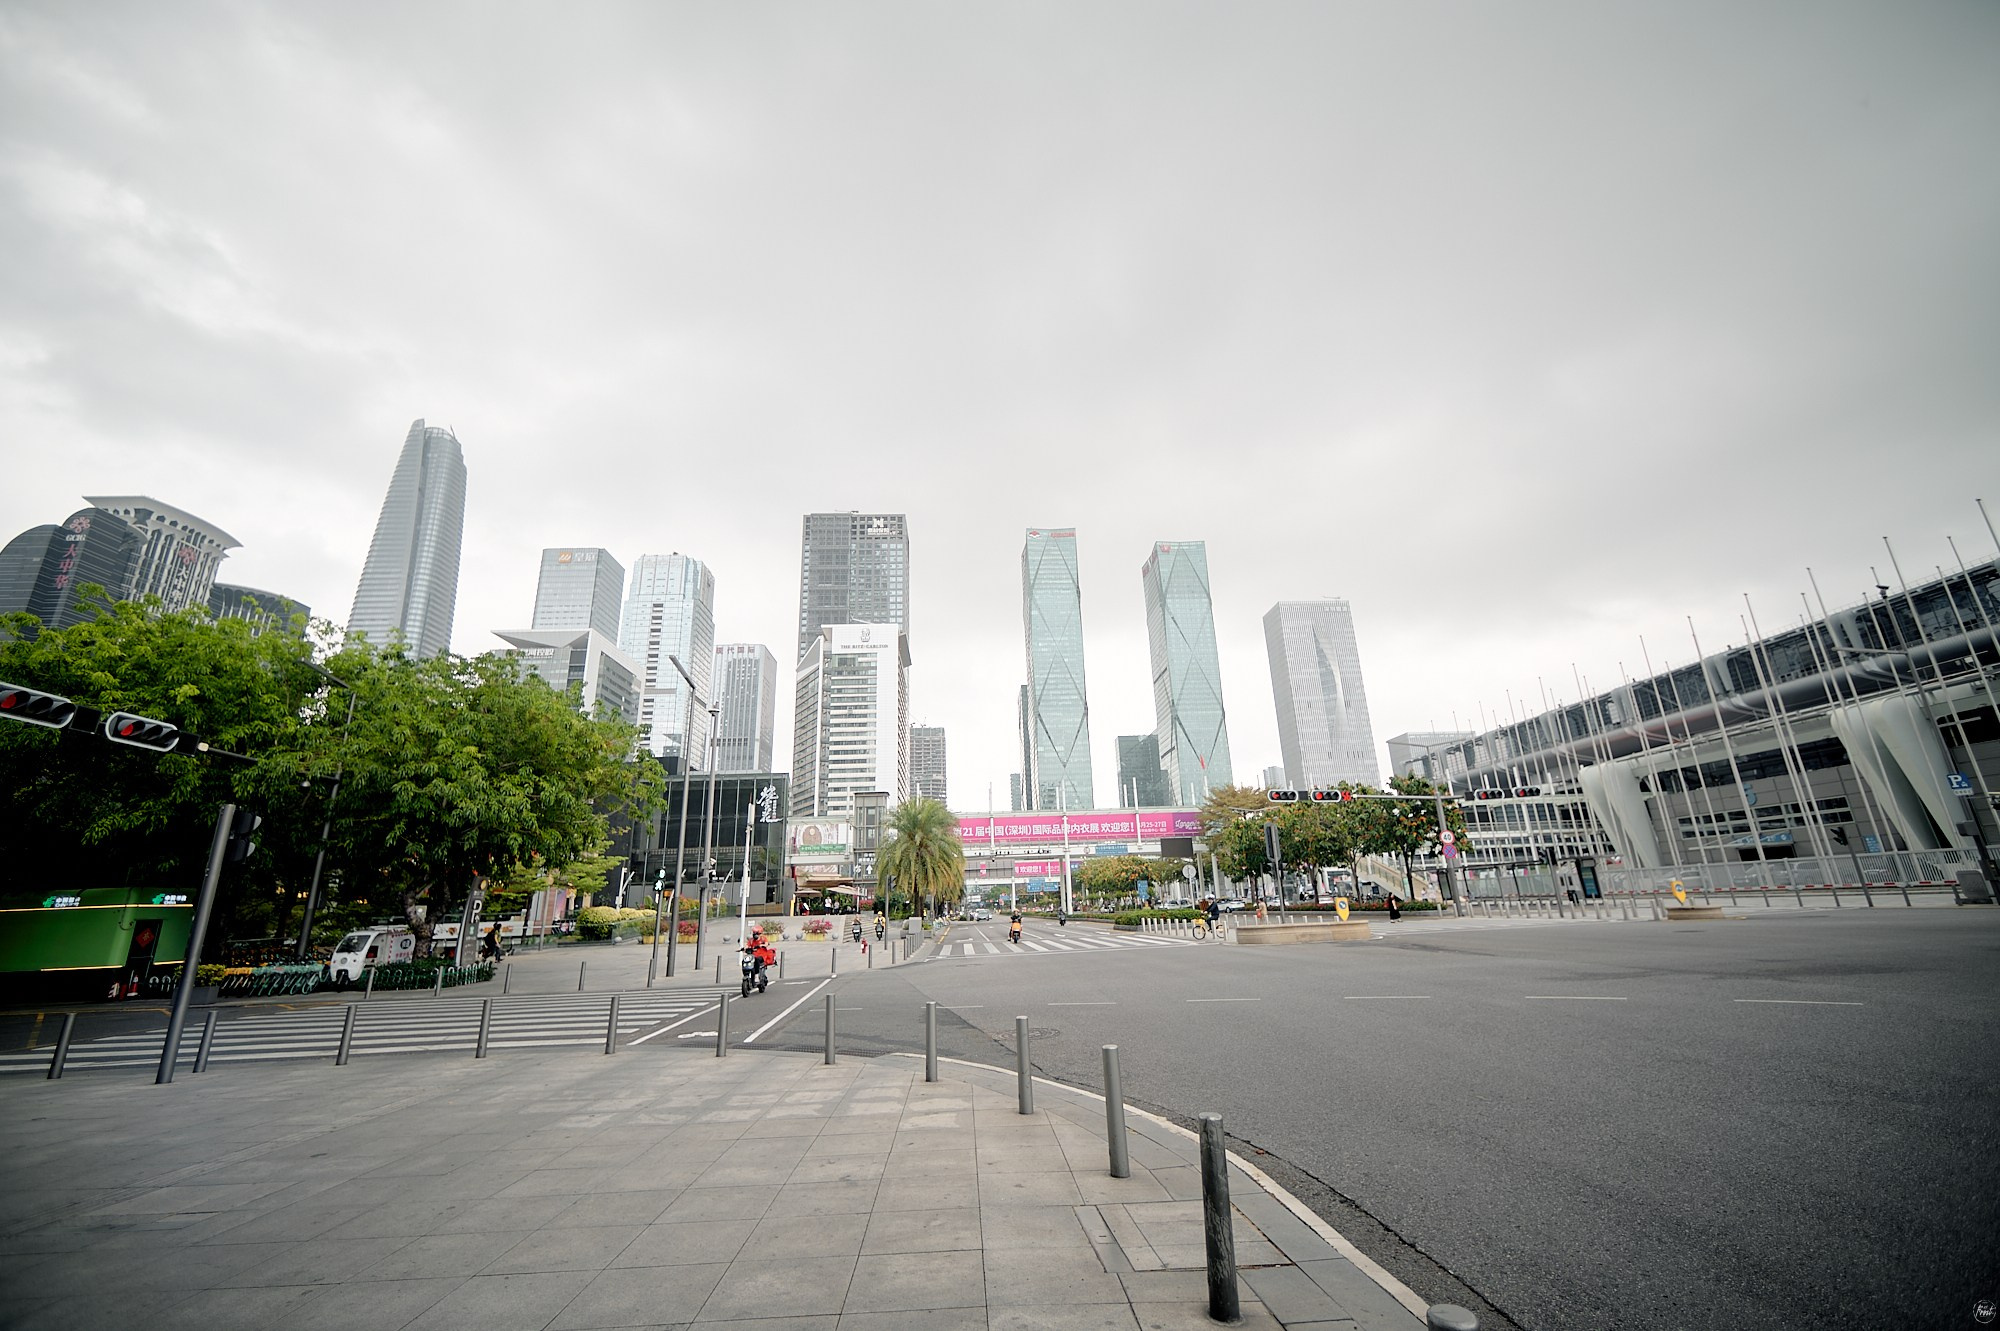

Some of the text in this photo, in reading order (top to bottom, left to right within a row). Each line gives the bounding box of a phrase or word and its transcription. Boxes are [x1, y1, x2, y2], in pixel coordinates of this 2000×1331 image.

[55, 543, 78, 589] 大中华
[1947, 774, 1962, 788] P
[470, 899, 482, 924] P
